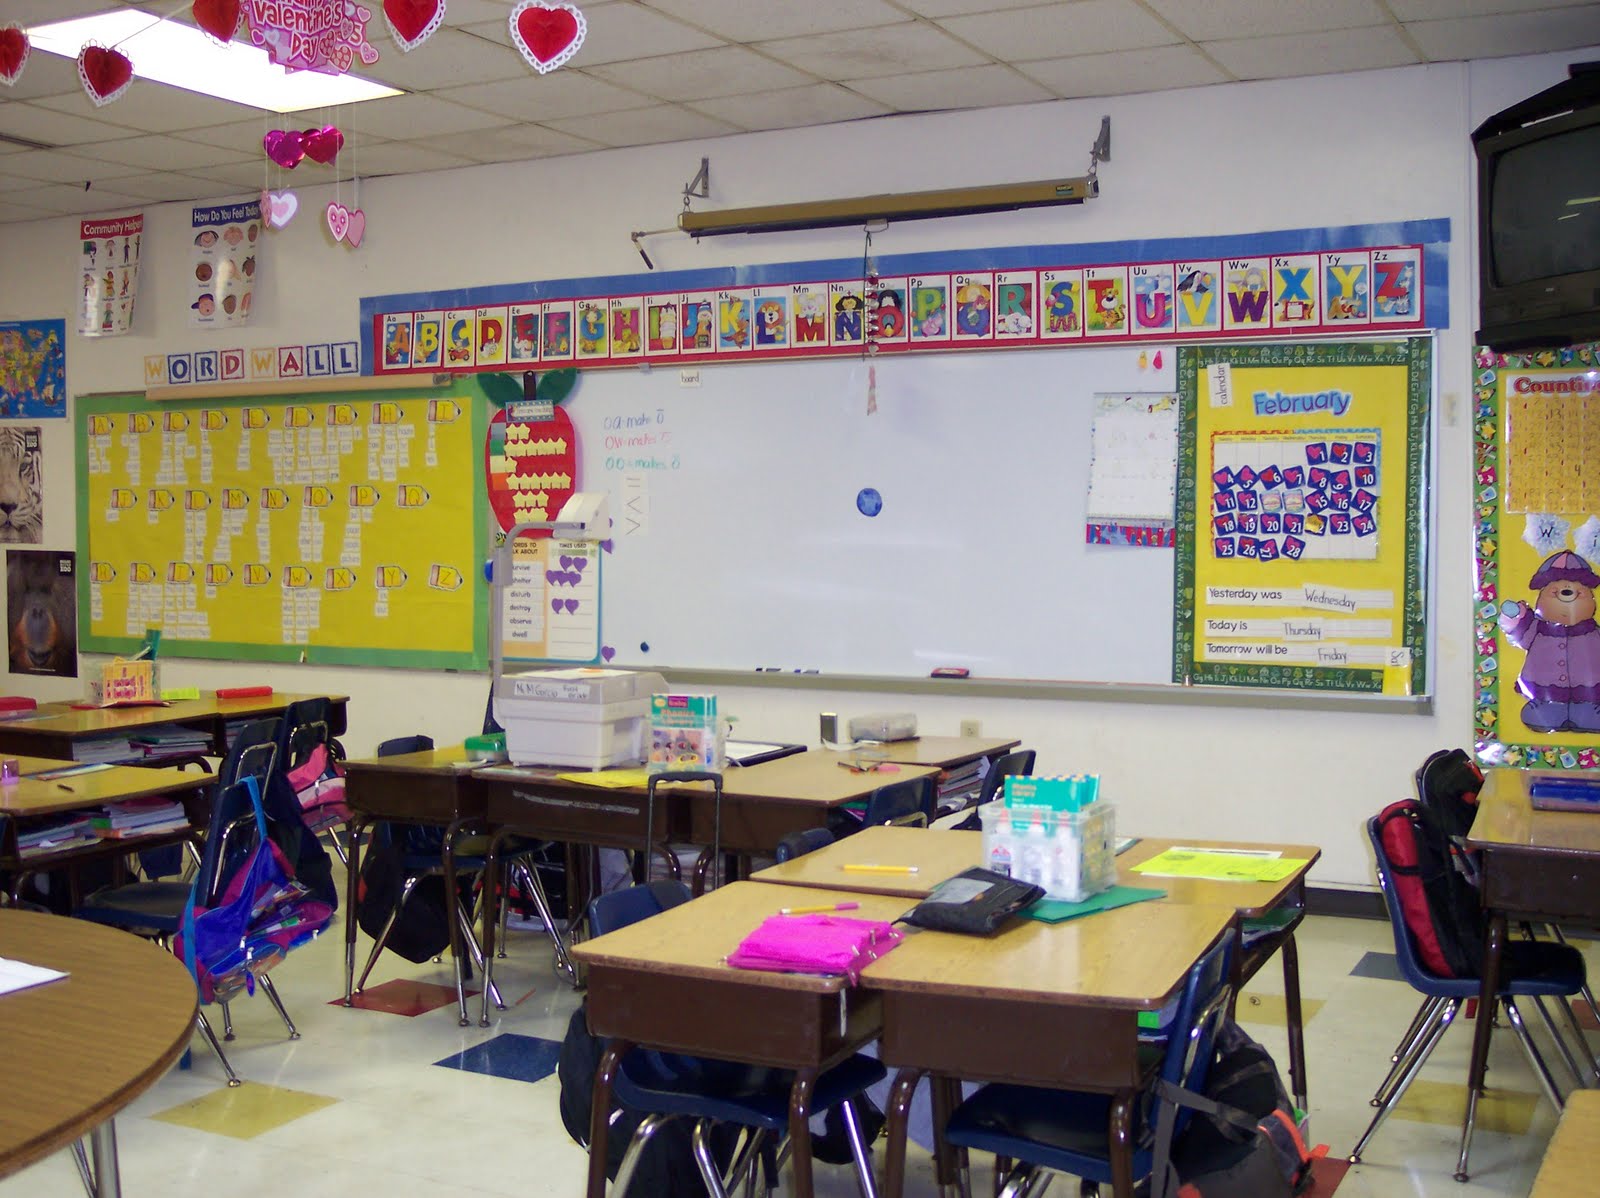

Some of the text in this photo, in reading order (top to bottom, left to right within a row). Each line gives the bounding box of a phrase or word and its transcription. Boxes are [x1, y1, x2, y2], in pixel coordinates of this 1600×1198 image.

[252, 1, 343, 35] Valentine's
[287, 30, 319, 63] Day
[83, 221, 124, 235] Community
[194, 209, 209, 222] How
[210, 210, 220, 222] Do
[221, 208, 232, 221] You
[232, 206, 244, 219] Feel
[1088, 280, 1114, 312] T
[1279, 269, 1311, 300] X
[1330, 266, 1364, 297] Y
[1375, 263, 1407, 298] Z
[918, 289, 942, 320] P
[1000, 286, 1027, 316] R
[1052, 282, 1073, 315] S
[1136, 293, 1165, 327] U
[1180, 292, 1213, 325] V
[1228, 291, 1268, 322] W
[481, 319, 502, 345] D
[516, 314, 534, 342] E
[547, 313, 566, 346] F
[582, 308, 605, 341] G
[616, 309, 639, 340] H
[651, 308, 660, 339] I
[683, 304, 700, 337] J
[721, 302, 742, 333] K
[756, 312, 775, 343] L
[796, 314, 825, 341] M
[835, 311, 861, 340] N
[878, 306, 904, 337] O
[958, 303, 991, 336] Q
[394, 324, 410, 353] A
[421, 323, 438, 352] B
[452, 320, 469, 348] C
[147, 347, 352, 379] WORD WALL
[681, 371, 699, 384] board
[1214, 366, 1228, 405] calendar
[1253, 391, 1353, 416] February
[1320, 451, 1372, 462] 1 2 3
[1228, 474, 1234, 484] 4
[1243, 480, 1252, 488] 5
[1273, 472, 1281, 483] 6
[1296, 474, 1302, 485] 7
[1319, 478, 1327, 488] 8
[1362, 474, 1373, 485] 10
[1225, 496, 1372, 510] 11 12 15 16 17
[1223, 520, 1234, 532] 18
[1245, 522, 1255, 532] 19
[1267, 521, 1278, 531] 20
[1290, 522, 1301, 533] 21
[1337, 522, 1348, 532] 23
[1360, 521, 1373, 533] 24
[1222, 544, 1300, 557] 25 26 27 28
[1208, 589, 1356, 611] Yesterday was Wednesday
[1207, 620, 1321, 638] Today is Thursday
[1206, 643, 1347, 664] Tomorrow will be Friday
